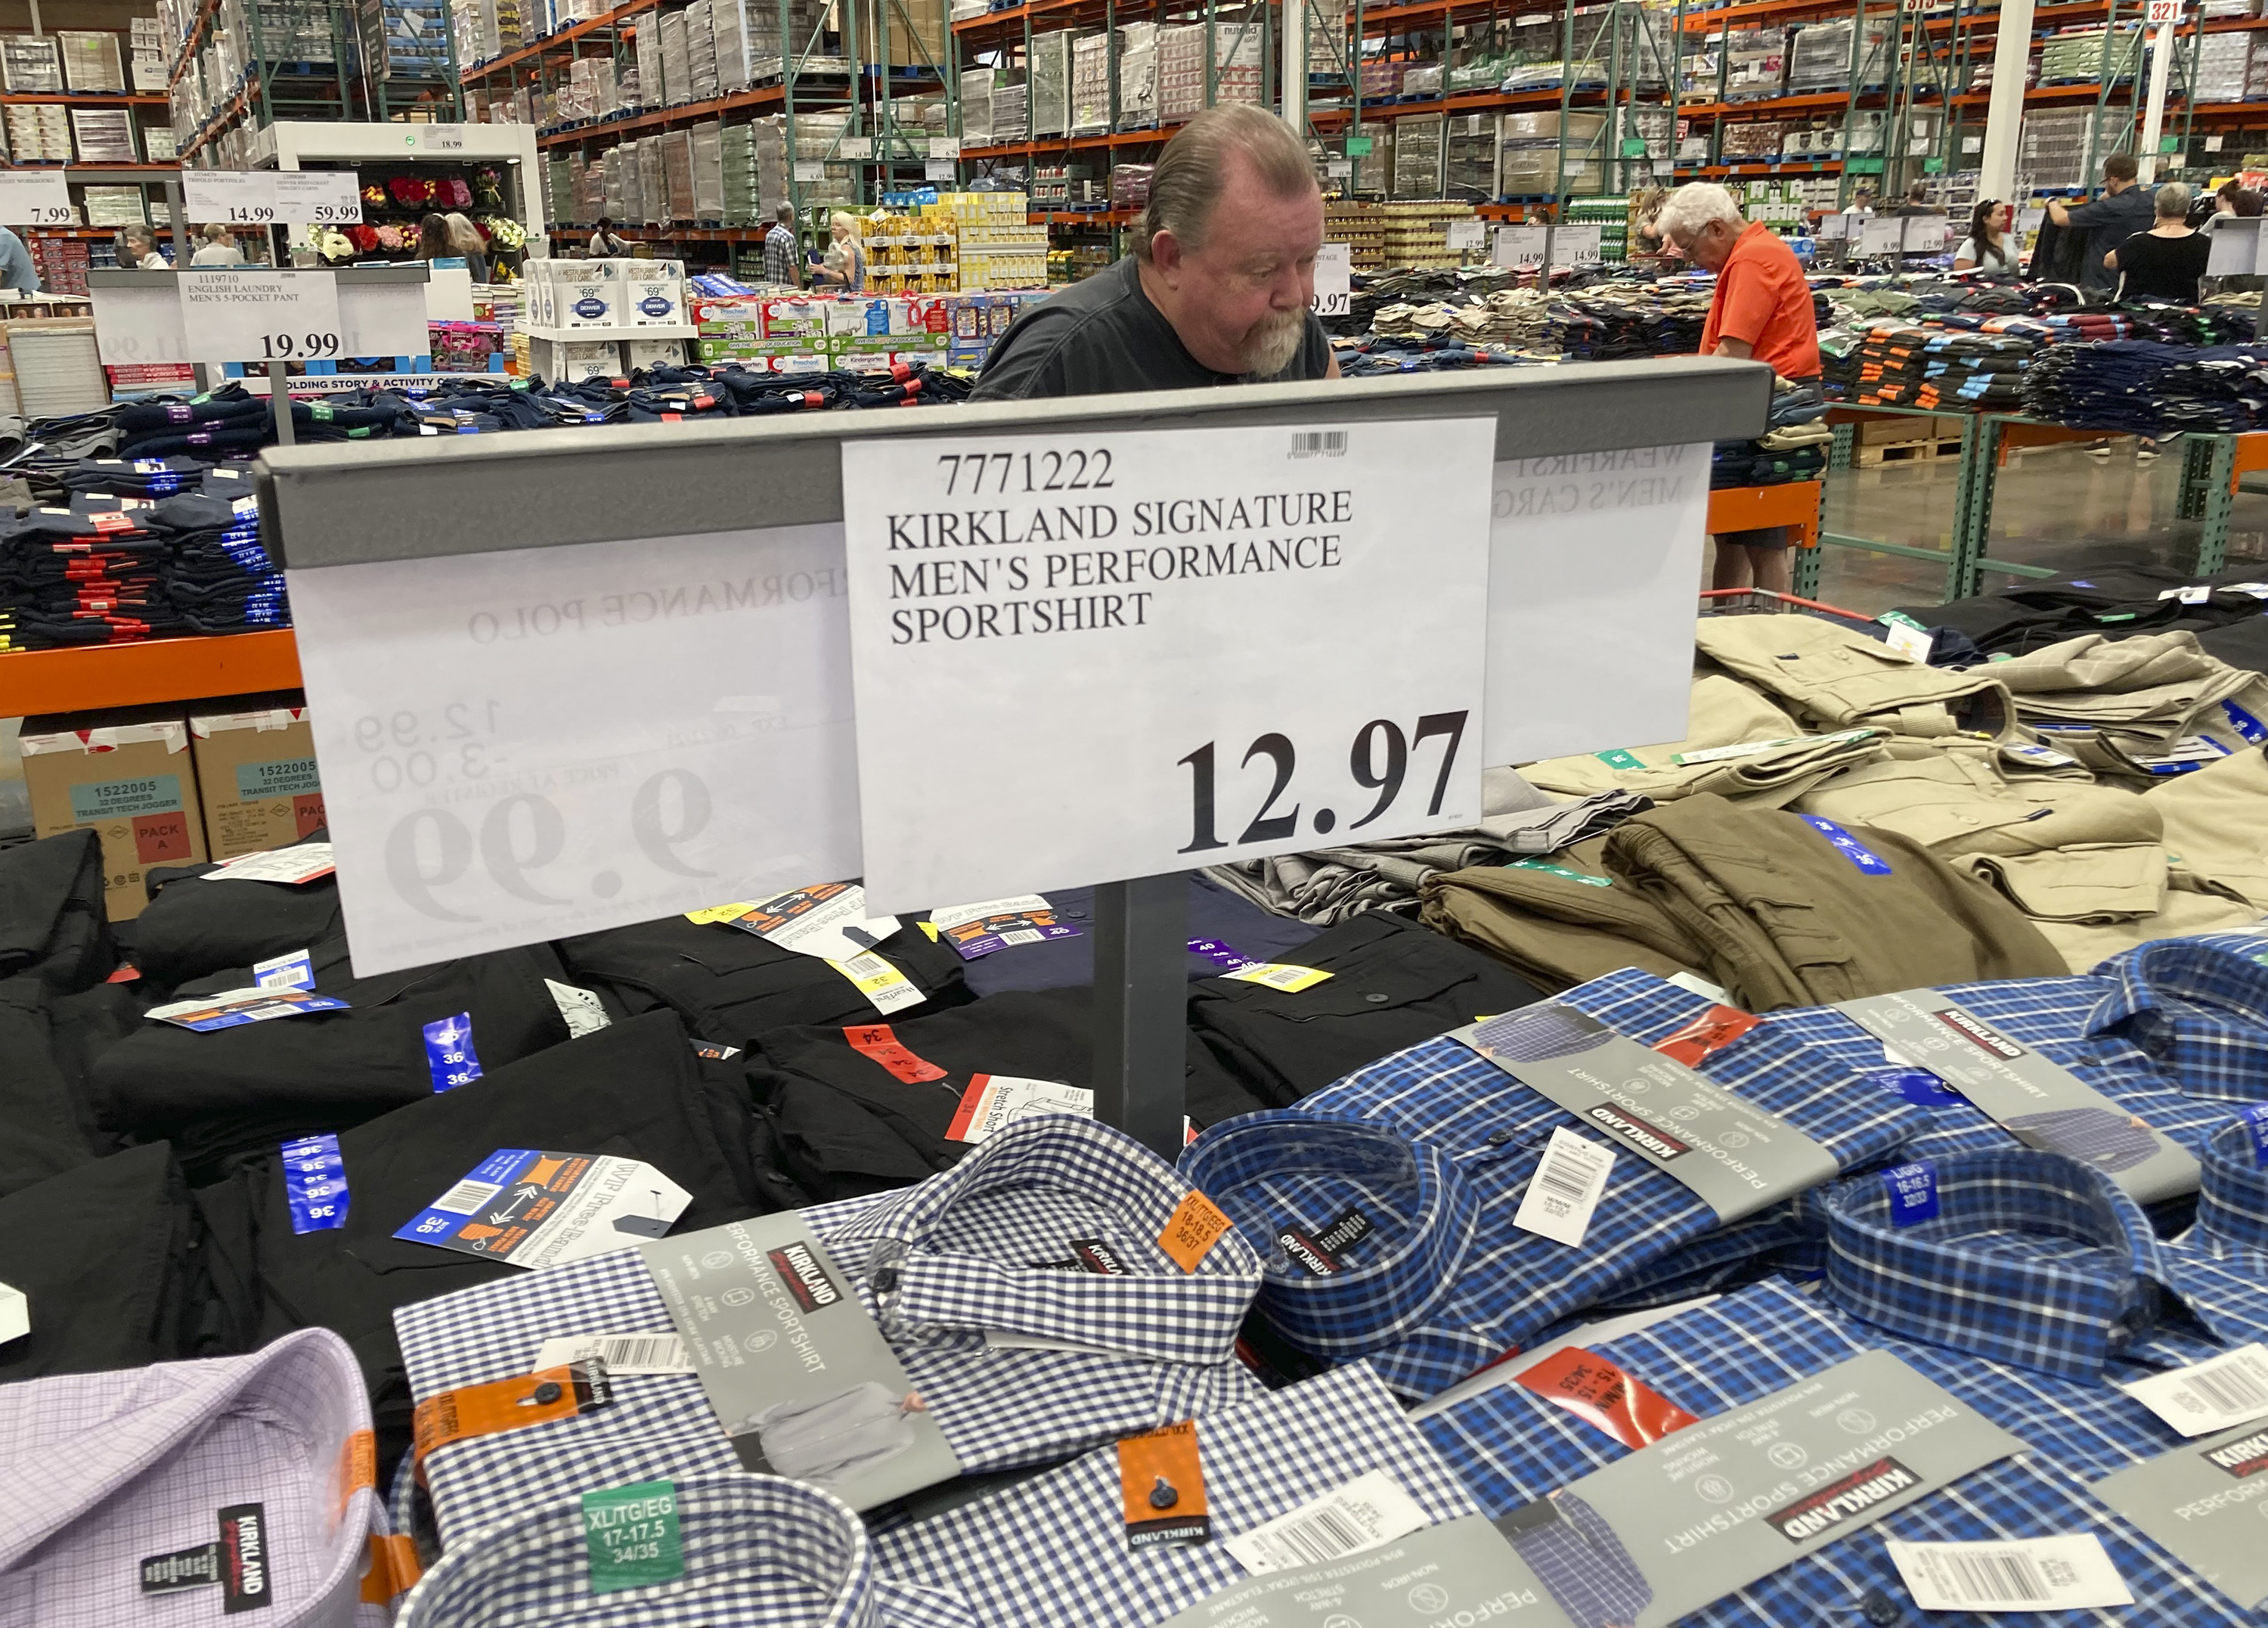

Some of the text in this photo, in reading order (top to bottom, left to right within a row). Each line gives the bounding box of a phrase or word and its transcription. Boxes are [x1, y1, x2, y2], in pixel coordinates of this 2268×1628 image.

[2152, 3, 2178, 20] 321
[31, 207, 70, 222] 7.99
[228, 206, 274, 222] 14.99
[315, 206, 358, 221] 59.99
[1466, 240, 1483, 248] 12.99
[1882, 242, 1899, 251] 9.99
[1923, 240, 1942, 250] 12.99
[1519, 253, 1544, 264] 14.99
[1574, 250, 1598, 262] 14.99
[199, 274, 239, 284] 1119710
[187, 285, 231, 293] ENGLISH
[190, 293, 299, 302] MEN'S 5-POCKET PANT
[260, 333, 339, 358] 19.99
[331, 380, 368, 389] STORY
[383, 378, 434, 386] ACTIVITY
[938, 448, 1115, 496] 7771222
[886, 490, 1353, 550] KIRKLAND SIGNATURE
[889, 535, 1342, 600] MEN'S PERFORMANCE
[891, 591, 1152, 645] SPORTSHIRT
[259, 761, 316, 777] 1522005
[273, 773, 313, 784] DEGREES
[94, 780, 156, 798] 1522005
[240, 783, 300, 796] TRANSIT TECH
[1176, 709, 1470, 855] 12.97
[76, 798, 178, 817] TRANSIT TECH JOGGER
[99, 793, 153, 807] 32 DEGREES
[299, 804, 325, 817] PAC
[139, 824, 179, 838] PACK
[157, 839, 168, 849] A
[965, 897, 1045, 917] Free-Band
[779, 906, 853, 948] Free-Band
[1199, 942, 1216, 951] 40
[871, 975, 888, 985] 32
[863, 1029, 883, 1044] 34
[1944, 1009, 2022, 1057] KIRKLAND
[1879, 993, 2050, 1099] RFORMANCE SPORTSHIRT
[442, 1051, 464, 1065] 36
[447, 1072, 469, 1085] 36
[1566, 1067, 1653, 1117] SPORTSHIRT
[962, 1101, 973, 1114] 34
[982, 1086, 1014, 1133] Stretch Short
[1591, 1108, 1678, 1158] KIRKLAND
[298, 1144, 322, 1156] 36
[1650, 1114, 1768, 1189] PERFORMANCE
[301, 1161, 326, 1172] 36
[303, 1174, 328, 1184] 36
[608, 1162, 640, 1192] WF
[1896, 1174, 1932, 1195] 16-16.5
[306, 1186, 330, 1199] 36
[308, 1205, 335, 1219] 36
[1184, 1194, 1225, 1233] XXL/TTG/EEG
[416, 1215, 442, 1234] 36
[432, 1219, 450, 1234] SIZE
[531, 1191, 615, 1270] Free-Band
[1181, 1211, 1211, 1242] 18-18.5
[1176, 1226, 1200, 1251] 36/37
[1280, 1233, 1332, 1276] KIRKLAND
[783, 1244, 837, 1305] KIRKLAND
[769, 1296, 826, 1373] SPORTSHIRT
[589, 1359, 606, 1405] KIRKLAND
[2209, 1432, 2268, 1468] KIRK
[1665, 1404, 1958, 1555] PERFORMANCE SPORTSHIRT
[1783, 1468, 1913, 1539] KIRKLAND
[2173, 1478, 2268, 1521] PERFORM
[589, 1496, 672, 1530] XL/TG/EG
[603, 1520, 666, 1548] 17-17.5
[1131, 1526, 1204, 1545] KIRKLAND
[237, 1515, 264, 1595] KIRKLAND
[612, 1542, 659, 1564] 34/35
[1380, 1561, 1439, 1591] NON-IRON
[1292, 1583, 1345, 1603] STRETCH
